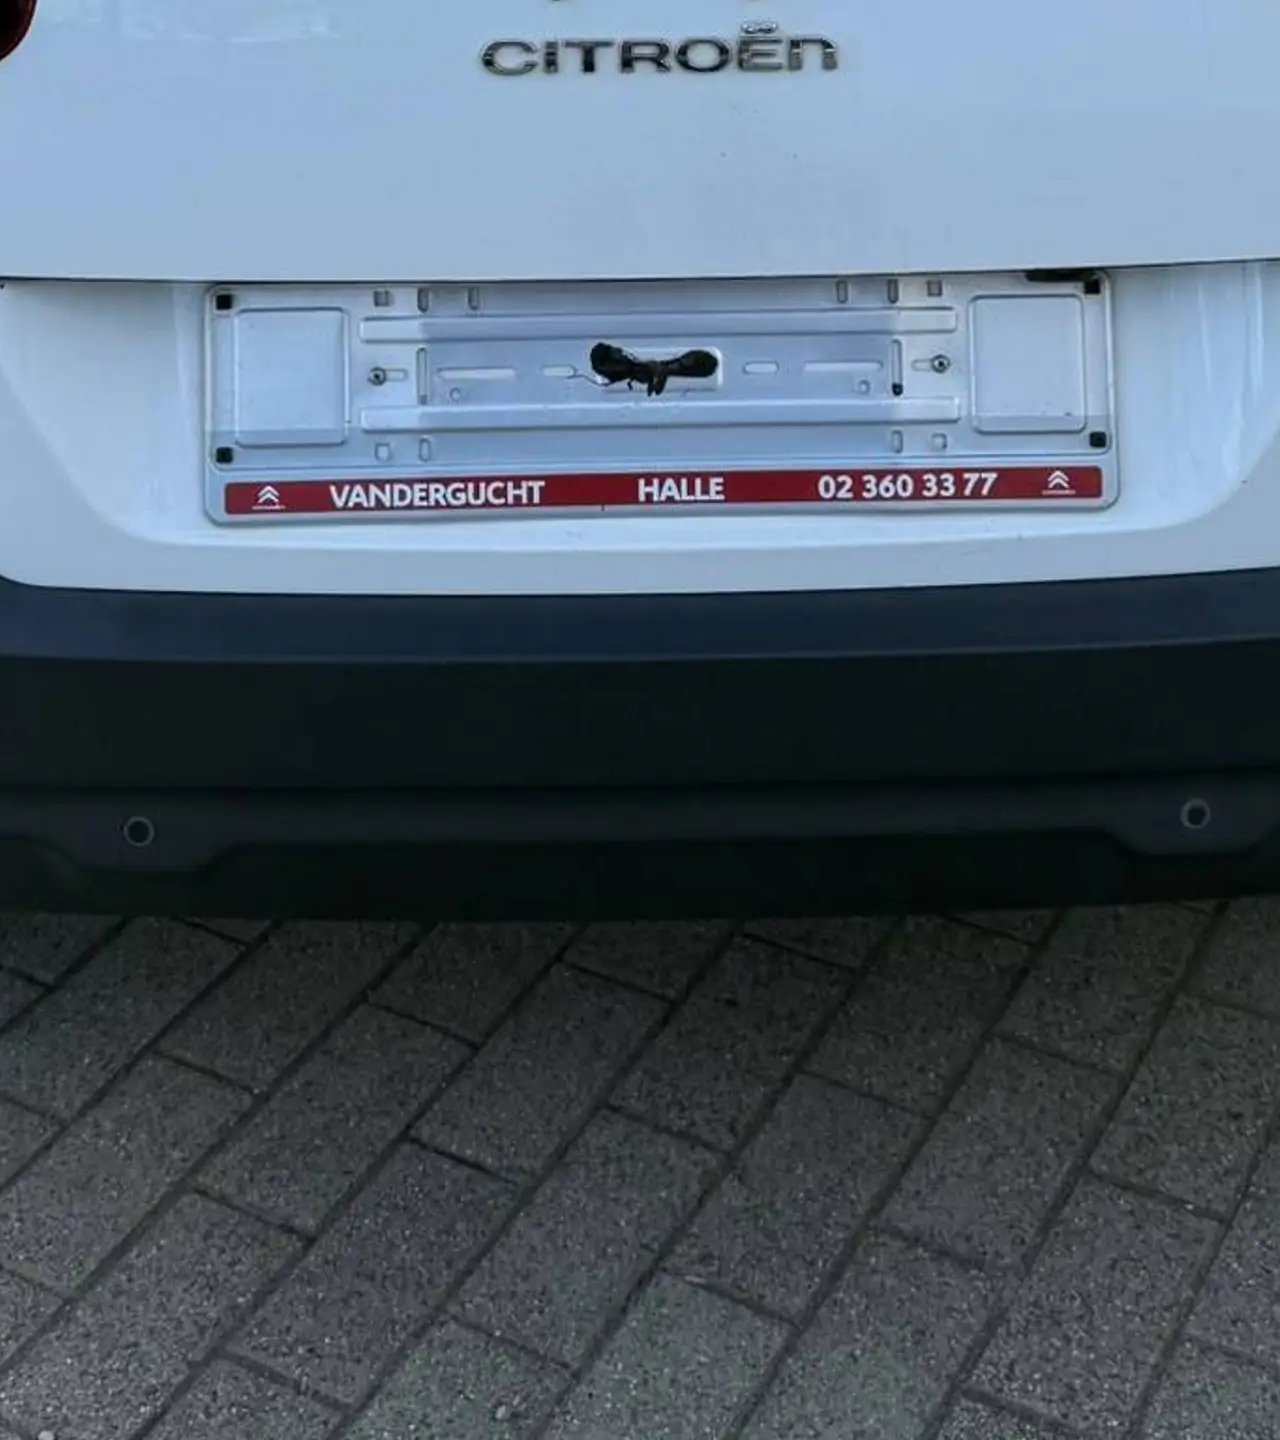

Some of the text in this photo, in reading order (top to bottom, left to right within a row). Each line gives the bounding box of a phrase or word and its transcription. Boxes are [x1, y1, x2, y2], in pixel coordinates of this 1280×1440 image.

[329, 471, 998, 509] VANDERGUCHT HALLE 02 360 33 77
